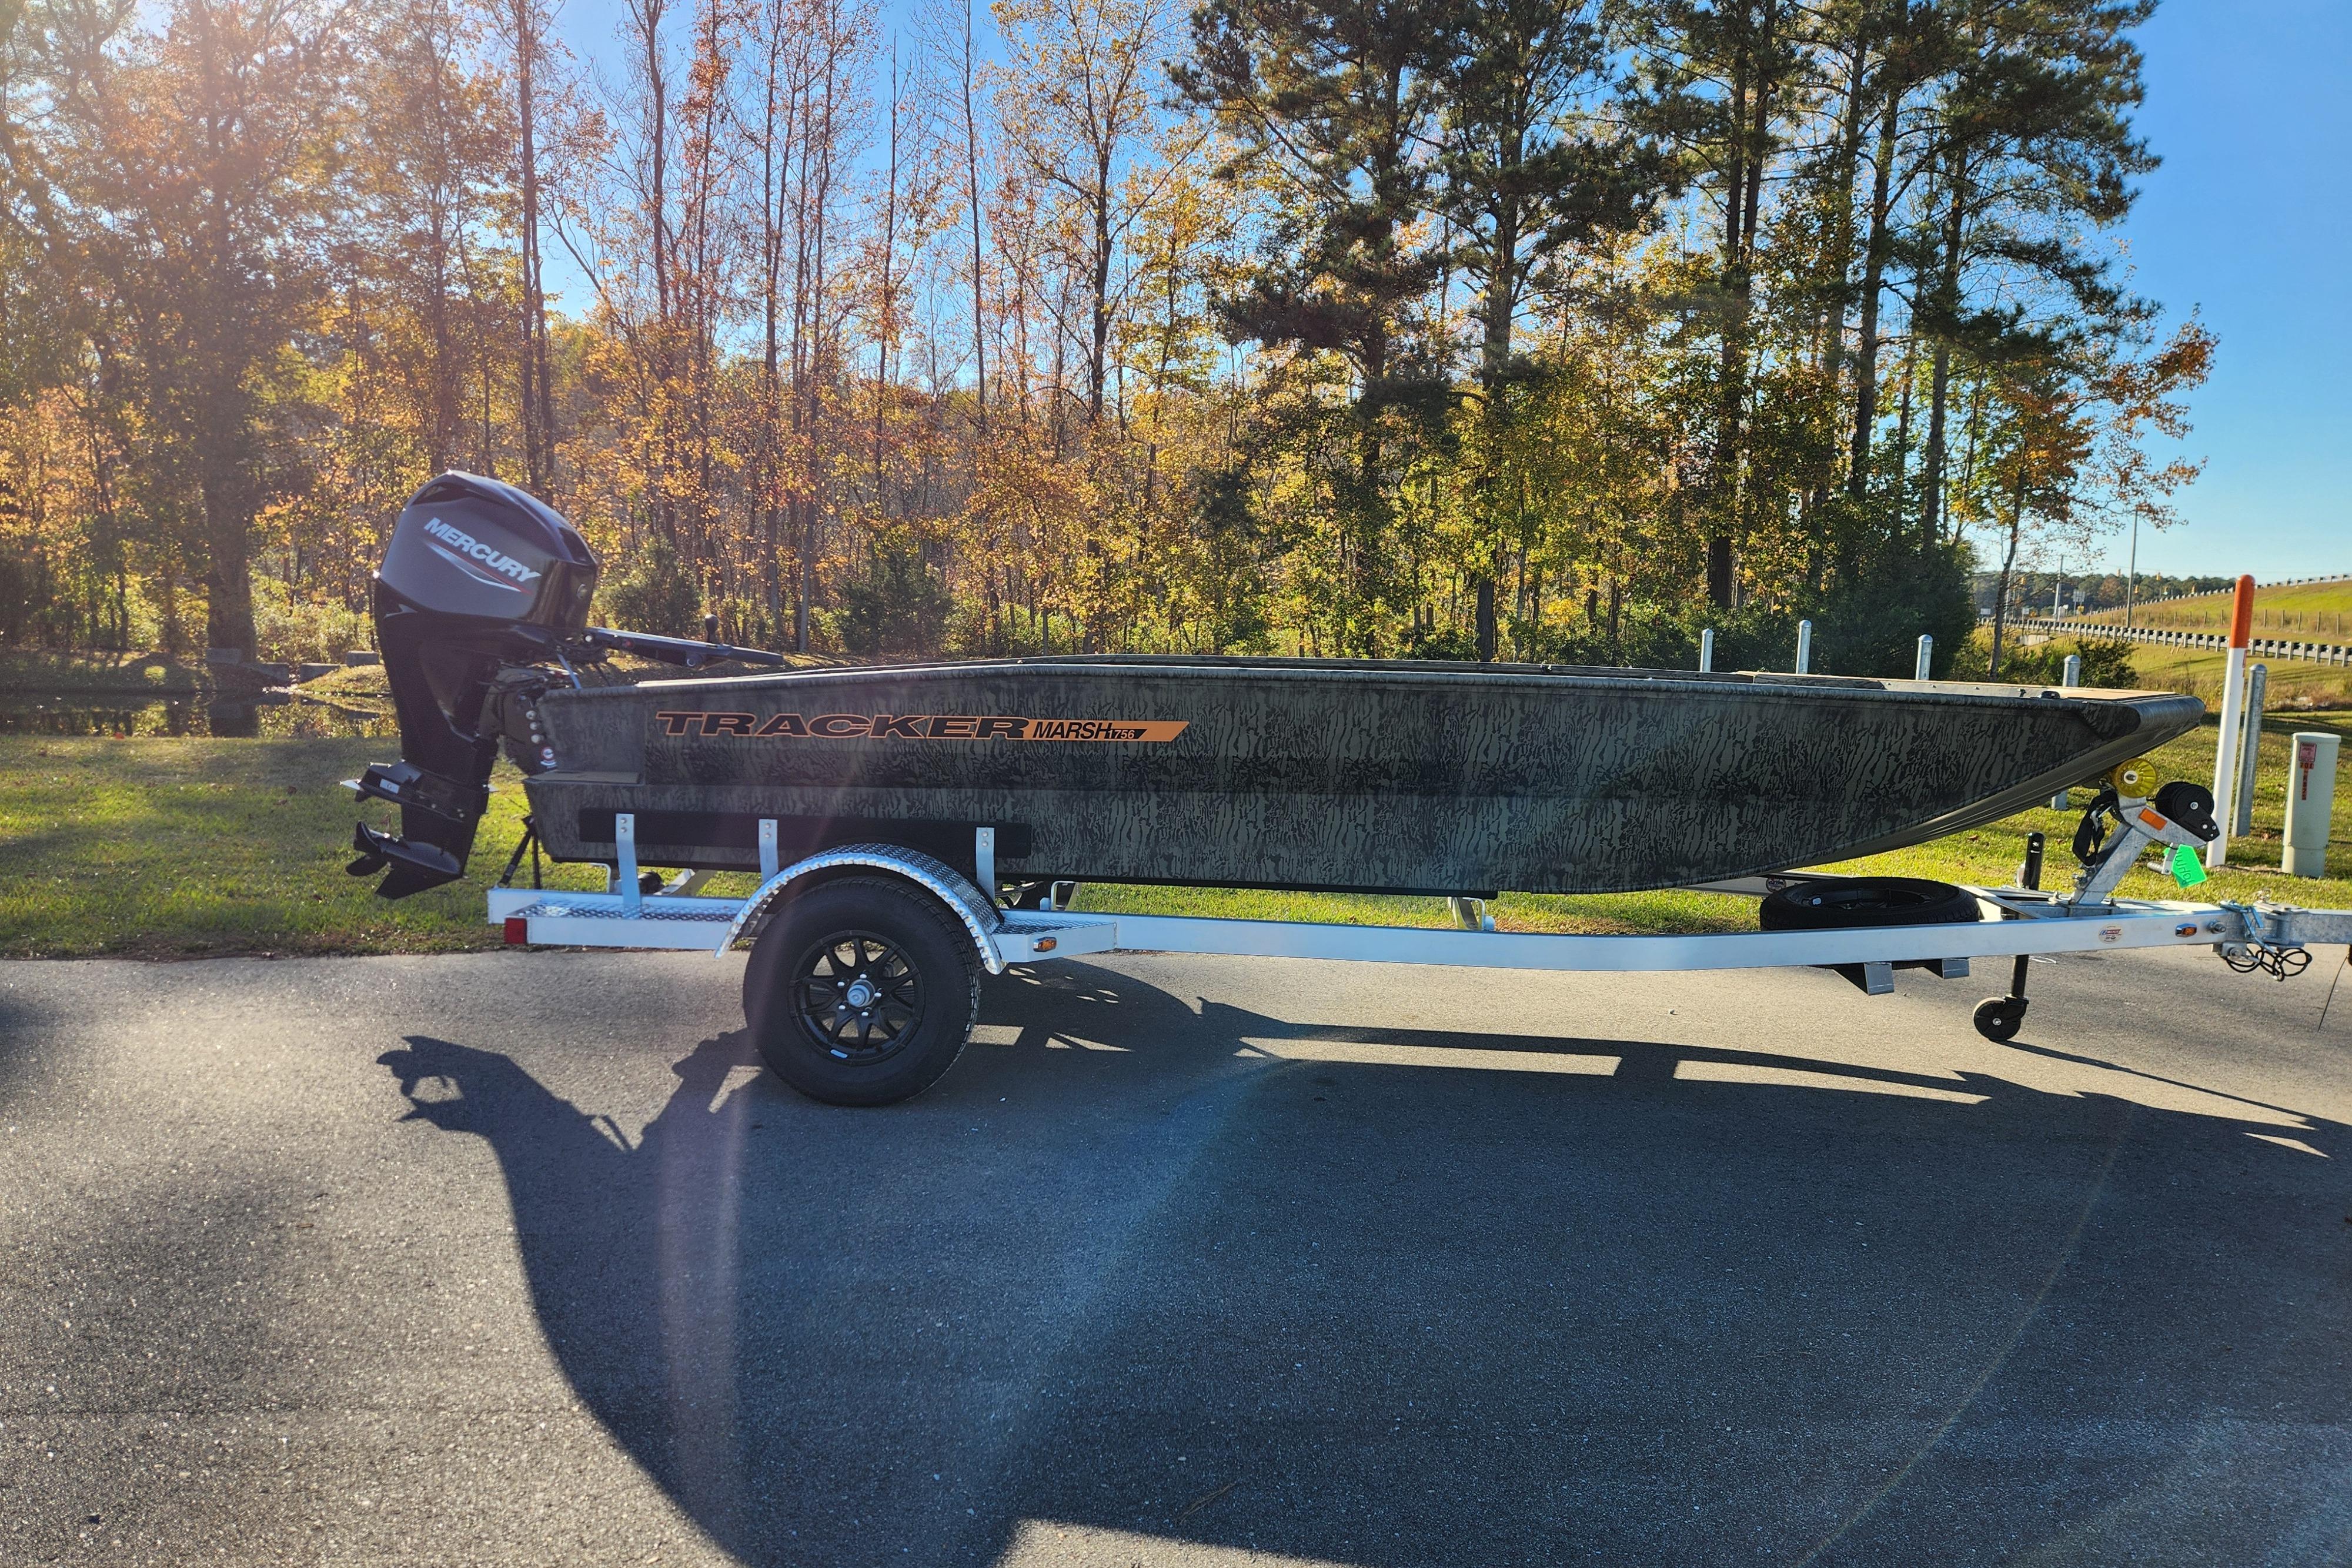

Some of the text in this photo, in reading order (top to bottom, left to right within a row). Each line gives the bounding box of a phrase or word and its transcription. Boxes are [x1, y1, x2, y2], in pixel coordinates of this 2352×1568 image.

[424, 517, 542, 582] MERCURY
[656, 711, 1135, 740] TRACKER MARSH 1756
